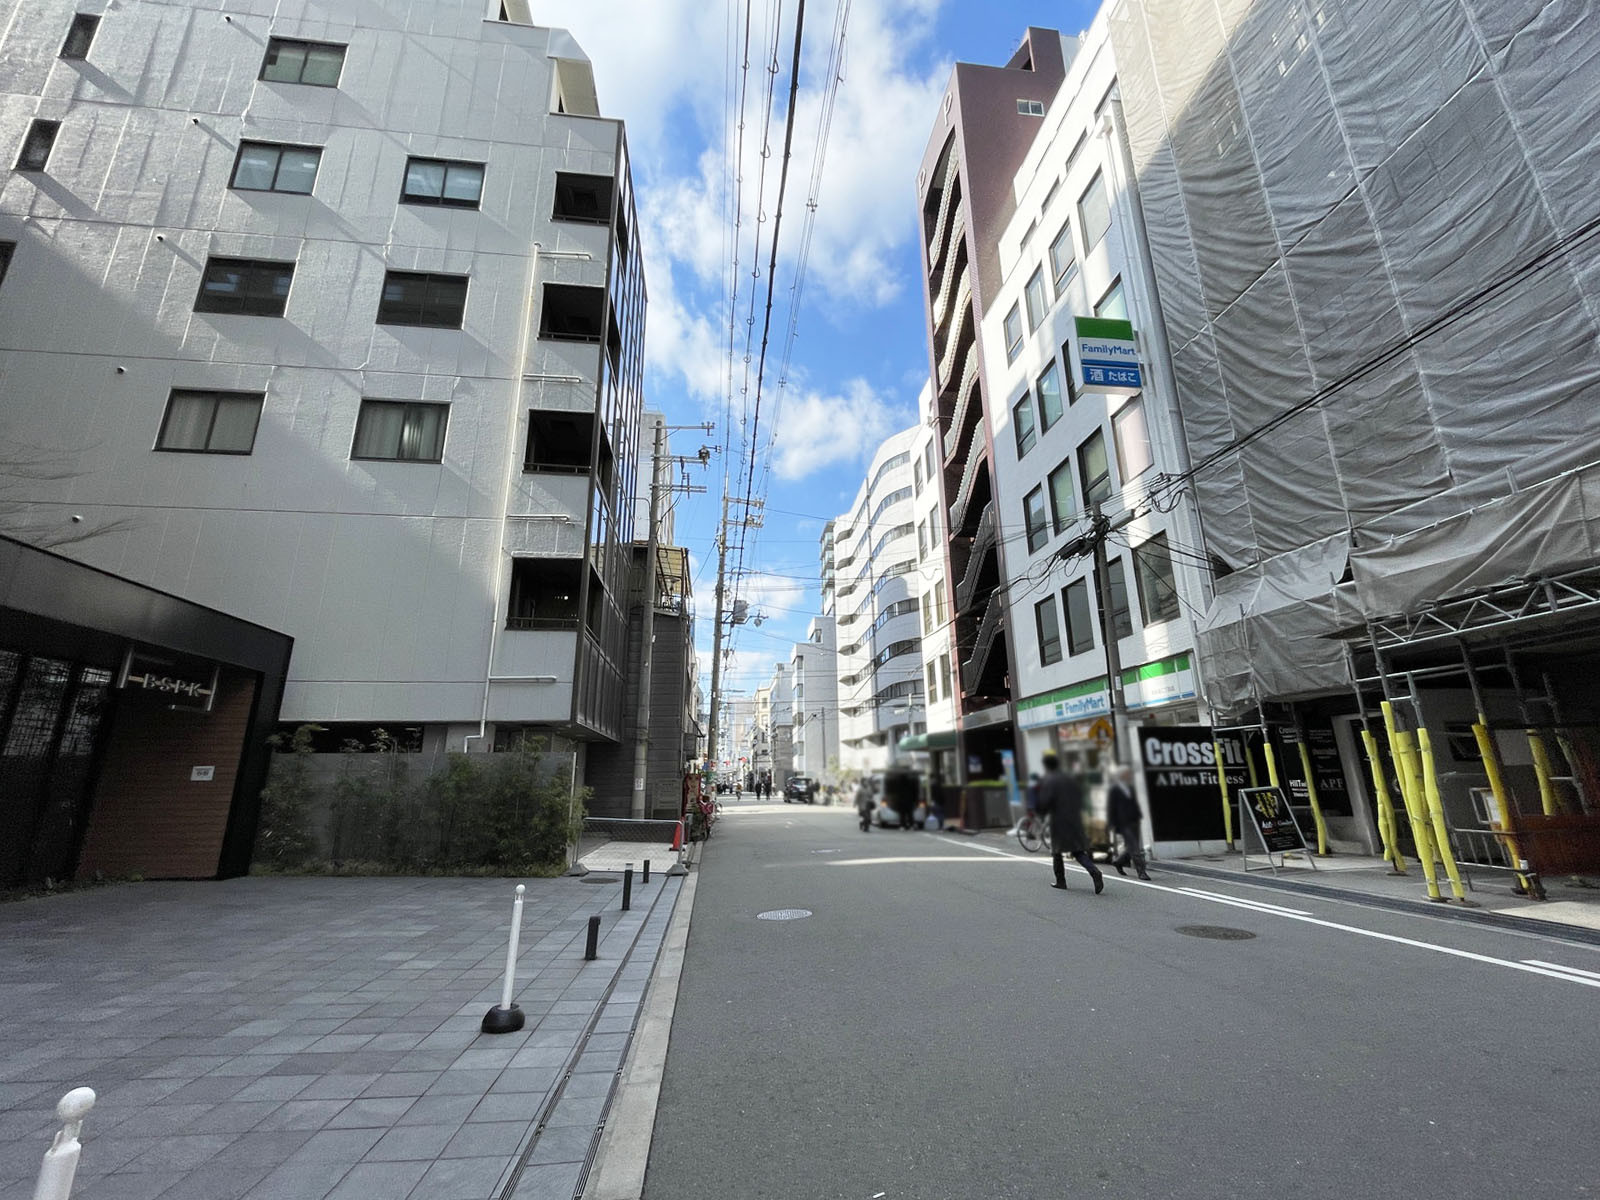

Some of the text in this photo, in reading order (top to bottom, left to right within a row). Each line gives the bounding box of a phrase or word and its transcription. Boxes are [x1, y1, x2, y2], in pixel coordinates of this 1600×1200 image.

[1082, 343, 1136, 355] FamilyMart
[1090, 369, 1137, 382] 酒 たばこ
[1065, 696, 1105, 714] FamilyMart
[1156, 771, 1245, 787] A Plus Fitess
